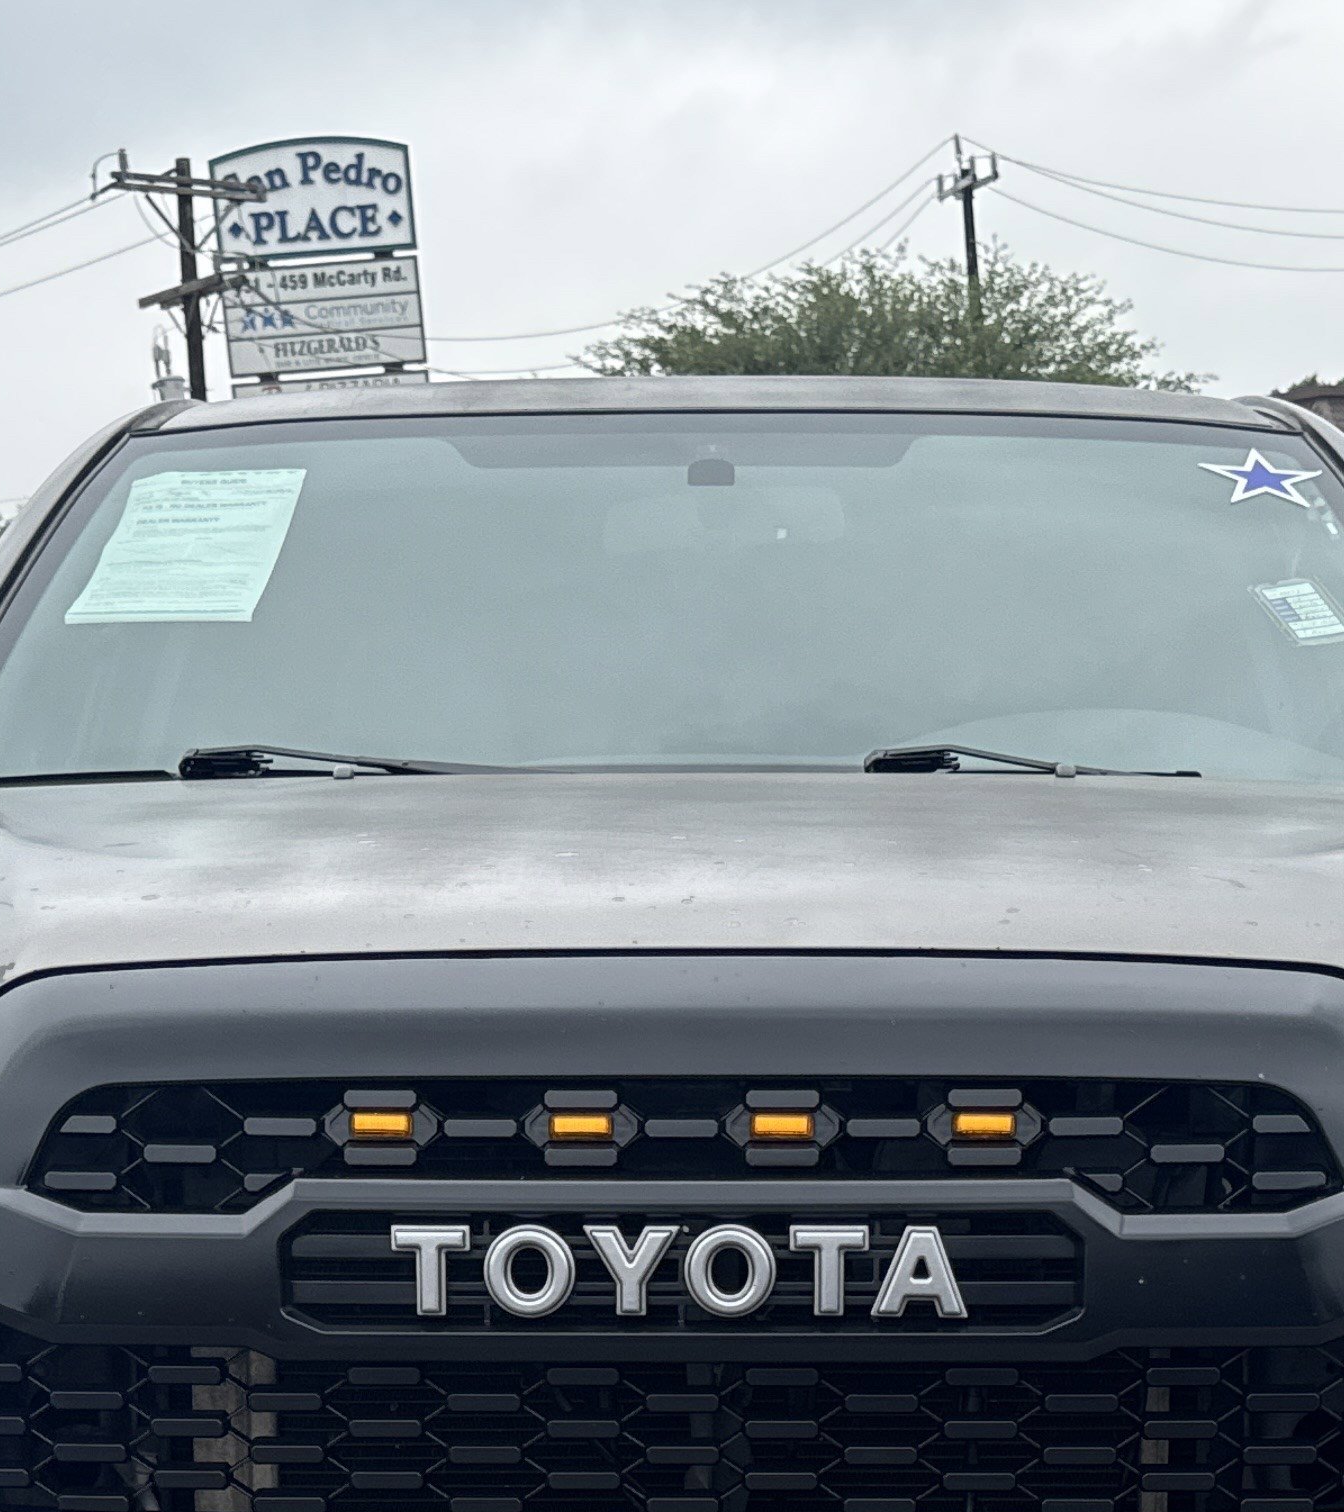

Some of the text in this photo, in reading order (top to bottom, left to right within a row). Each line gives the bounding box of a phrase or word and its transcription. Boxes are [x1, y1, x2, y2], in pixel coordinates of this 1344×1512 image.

[295, 150, 403, 195] Pedro
[249, 203, 382, 246] PLACE
[279, 273, 307, 291] 459
[313, 270, 377, 289] McCarty
[381, 266, 408, 283] Rd.
[303, 298, 408, 321] Community
[391, 1223, 968, 1319] TOYOTA
